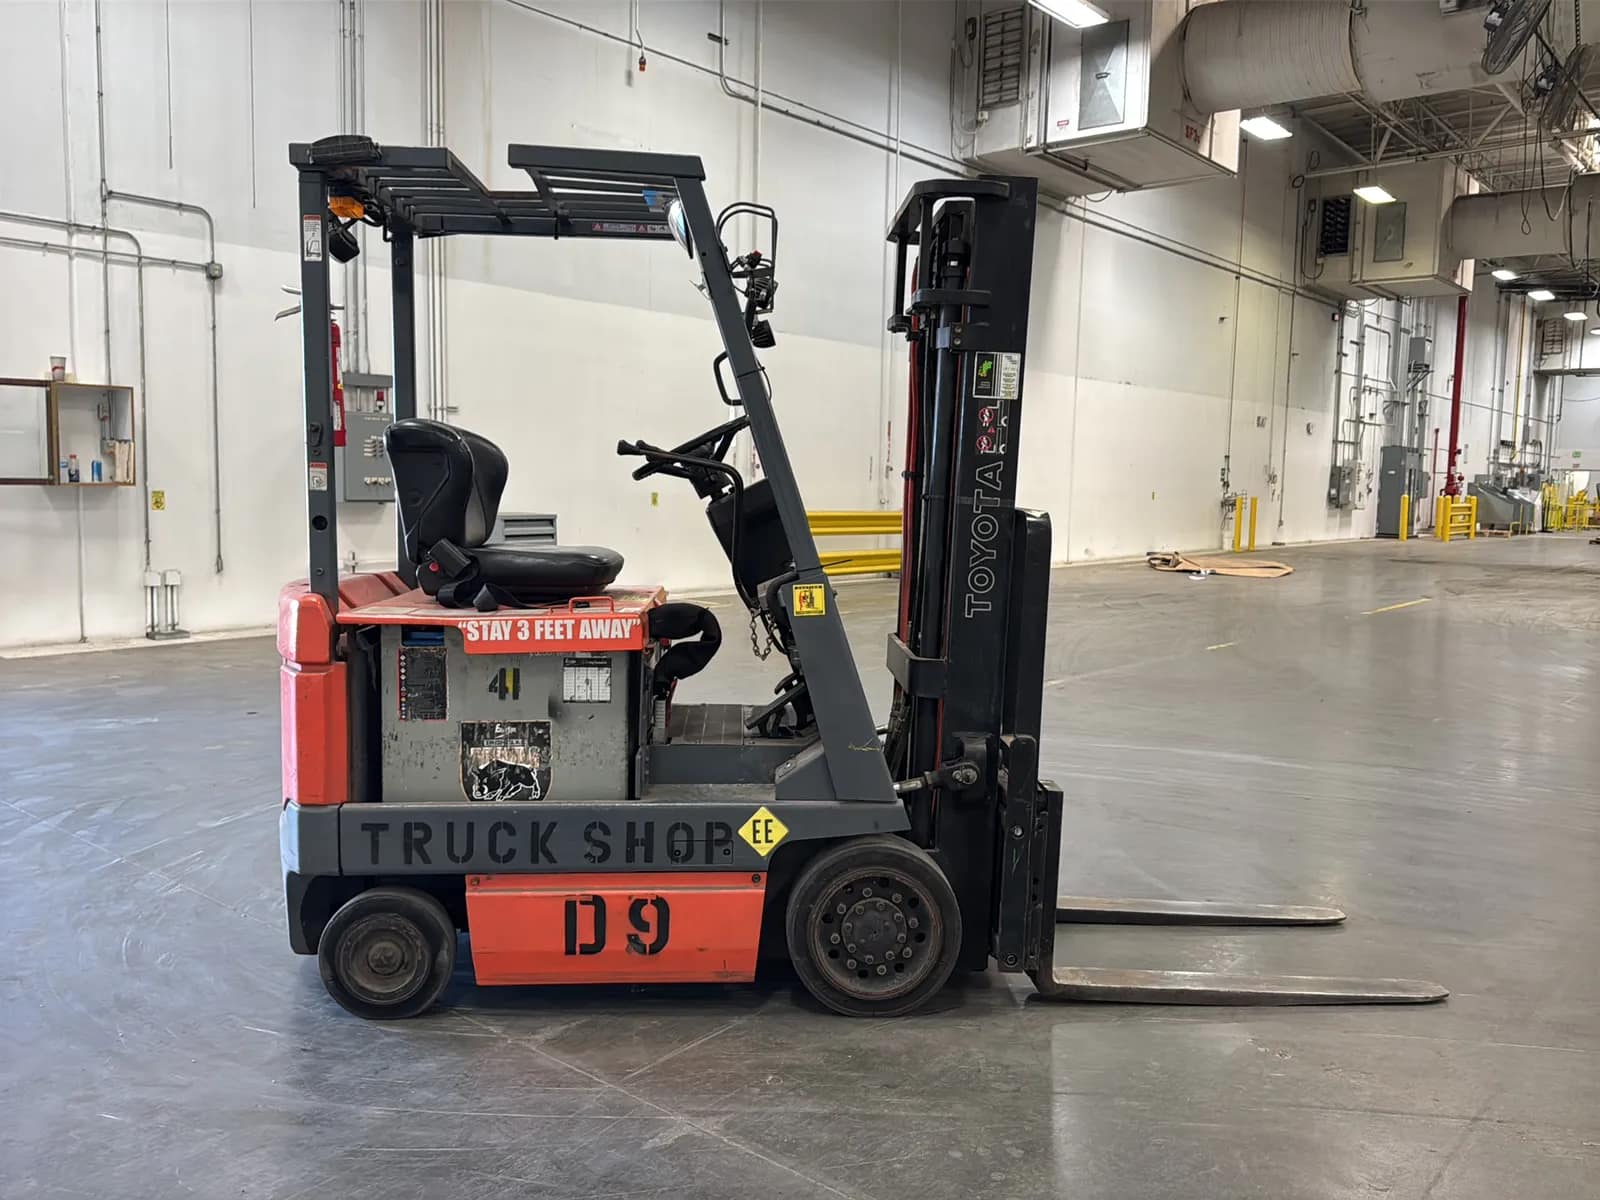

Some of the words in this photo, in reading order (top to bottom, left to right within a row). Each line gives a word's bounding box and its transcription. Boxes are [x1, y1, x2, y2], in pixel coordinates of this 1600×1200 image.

[965, 461, 1003, 618] TOYOTA
[517, 619, 530, 640] 3
[535, 619, 575, 640] FEET
[360, 821, 559, 865] TRUCK
[583, 821, 733, 864] SHOP
[752, 819, 774, 843] EE
